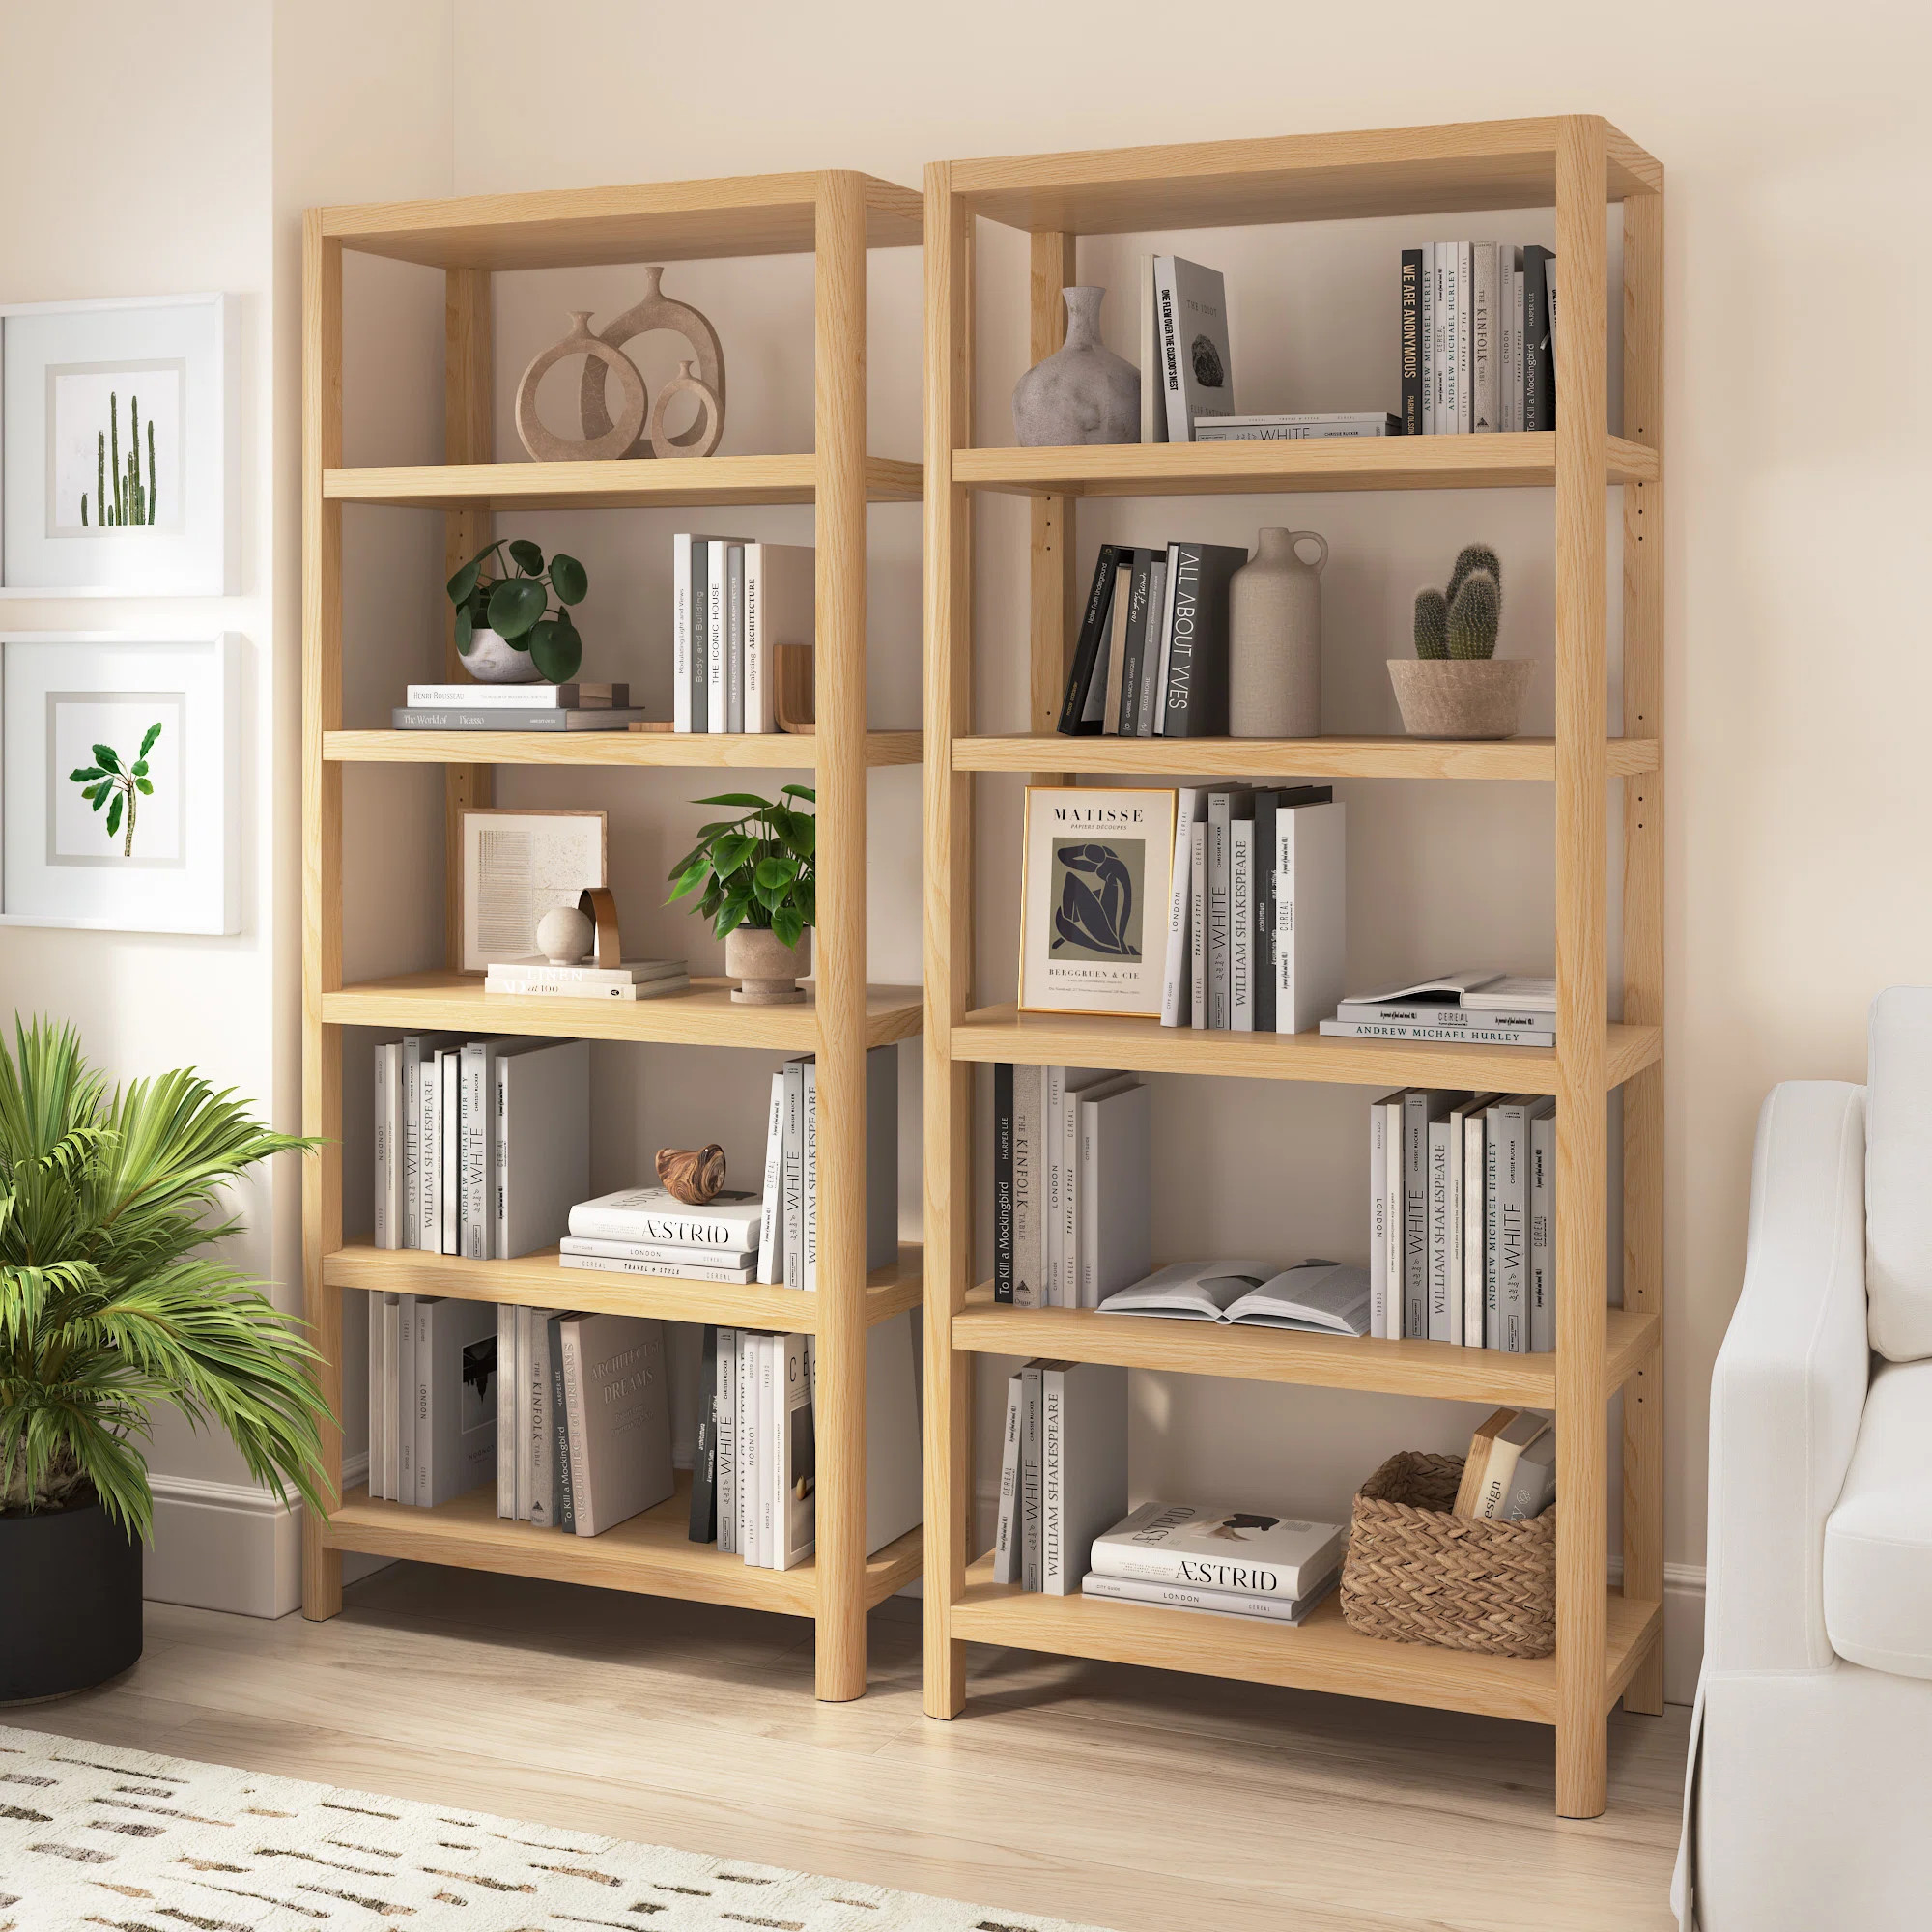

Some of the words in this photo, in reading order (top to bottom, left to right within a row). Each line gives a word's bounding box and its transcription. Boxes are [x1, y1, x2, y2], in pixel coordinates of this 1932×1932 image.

[1404, 264, 1416, 282] WE
[1163, 301, 1172, 318] FLEW
[1187, 299, 1198, 312] THE
[1201, 304, 1217, 318] IDIOT
[1404, 285, 1416, 306] ARE
[1164, 318, 1173, 334] OVER
[1165, 334, 1174, 347] THE
[1477, 308, 1487, 362] KINFOLK
[1404, 309, 1416, 379] ANONYMOUS
[1167, 347, 1177, 378] CUCKOO'S
[1526, 344, 1536, 395] Mockingbird
[1259, 427, 1310, 440] WHITE
[1527, 422, 1534, 432] To
[1179, 551, 1199, 585] ALL
[1087, 609, 1096, 624] Notes
[1094, 563, 1107, 596] Underground
[1140, 594, 1146, 604] of
[696, 591, 704, 631] Building
[1173, 590, 1196, 657] ABOUT
[696, 635, 704, 654] and
[696, 657, 704, 683] Body
[413, 691, 432, 700] HENRI
[433, 691, 465, 700] ROUSSEAU
[1169, 665, 1190, 709] YVES
[403, 714, 416, 724] The
[416, 714, 440, 724] World
[440, 714, 448, 724] of
[459, 714, 485, 724] Picasso
[1054, 808, 1143, 823] MATISSE
[1236, 840, 1246, 938] SHAKESPEARE
[1172, 892, 1180, 932] LONDON
[1212, 887, 1226, 950] WHITE
[1280, 900, 1289, 931] CEREAL
[526, 968, 582, 982] LINEN
[541, 984, 559, 993] 100
[1049, 968, 1107, 978] BERGGRUEN
[1236, 940, 1246, 1007] WILLIAM
[1355, 1026, 1407, 1036] ANDREW
[1412, 1028, 1466, 1039] MICHAEL
[1471, 1032, 1520, 1041] HURLEY
[1437, 1012, 1469, 1023] CEREAL
[407, 1120, 417, 1176] WHITE
[470, 1128, 483, 1185] WHITE
[787, 1151, 800, 1211] WHITE
[1016, 1138, 1029, 1208] KINFOLK
[1435, 1144, 1445, 1244] SHAKESPEARE
[641, 1219, 729, 1244] ÆSTRID
[999, 1181, 1011, 1249] Mockingbird
[1409, 1190, 1423, 1255] WHITE
[1534, 1215, 1543, 1247] CEREAL
[1504, 1203, 1521, 1269] WHITE
[582, 1260, 606, 1269] CEREAL
[624, 1264, 648, 1272] TRAVEL
[706, 1272, 731, 1281] CEREAL
[1000, 1262, 1009, 1278] Kill
[1435, 1248, 1445, 1315] WILLIAM
[1000, 1280, 1009, 1295] To
[564, 1343, 580, 1410] DREAMS
[591, 1344, 649, 1381] ARCHITECT
[650, 1339, 663, 1353] of
[604, 1368, 654, 1404] DREAMS
[533, 1382, 542, 1441] KINFOLK
[572, 1414, 580, 1427] of
[558, 1426, 570, 1484] Mockingbird
[720, 1416, 732, 1476] WHITE
[1048, 1393, 1058, 1503] SHAKESPEARE
[572, 1433, 587, 1522] ARCHITECT
[1003, 1467, 1012, 1496] CEREAL
[1026, 1460, 1038, 1520] WHITE
[564, 1512, 573, 1522] To
[1048, 1506, 1058, 1577] WILLIAM
[1175, 1560, 1277, 1591] ÆSTRID
[1163, 1592, 1200, 1603] LONDON
[1248, 1604, 1271, 1612] CEREAL
